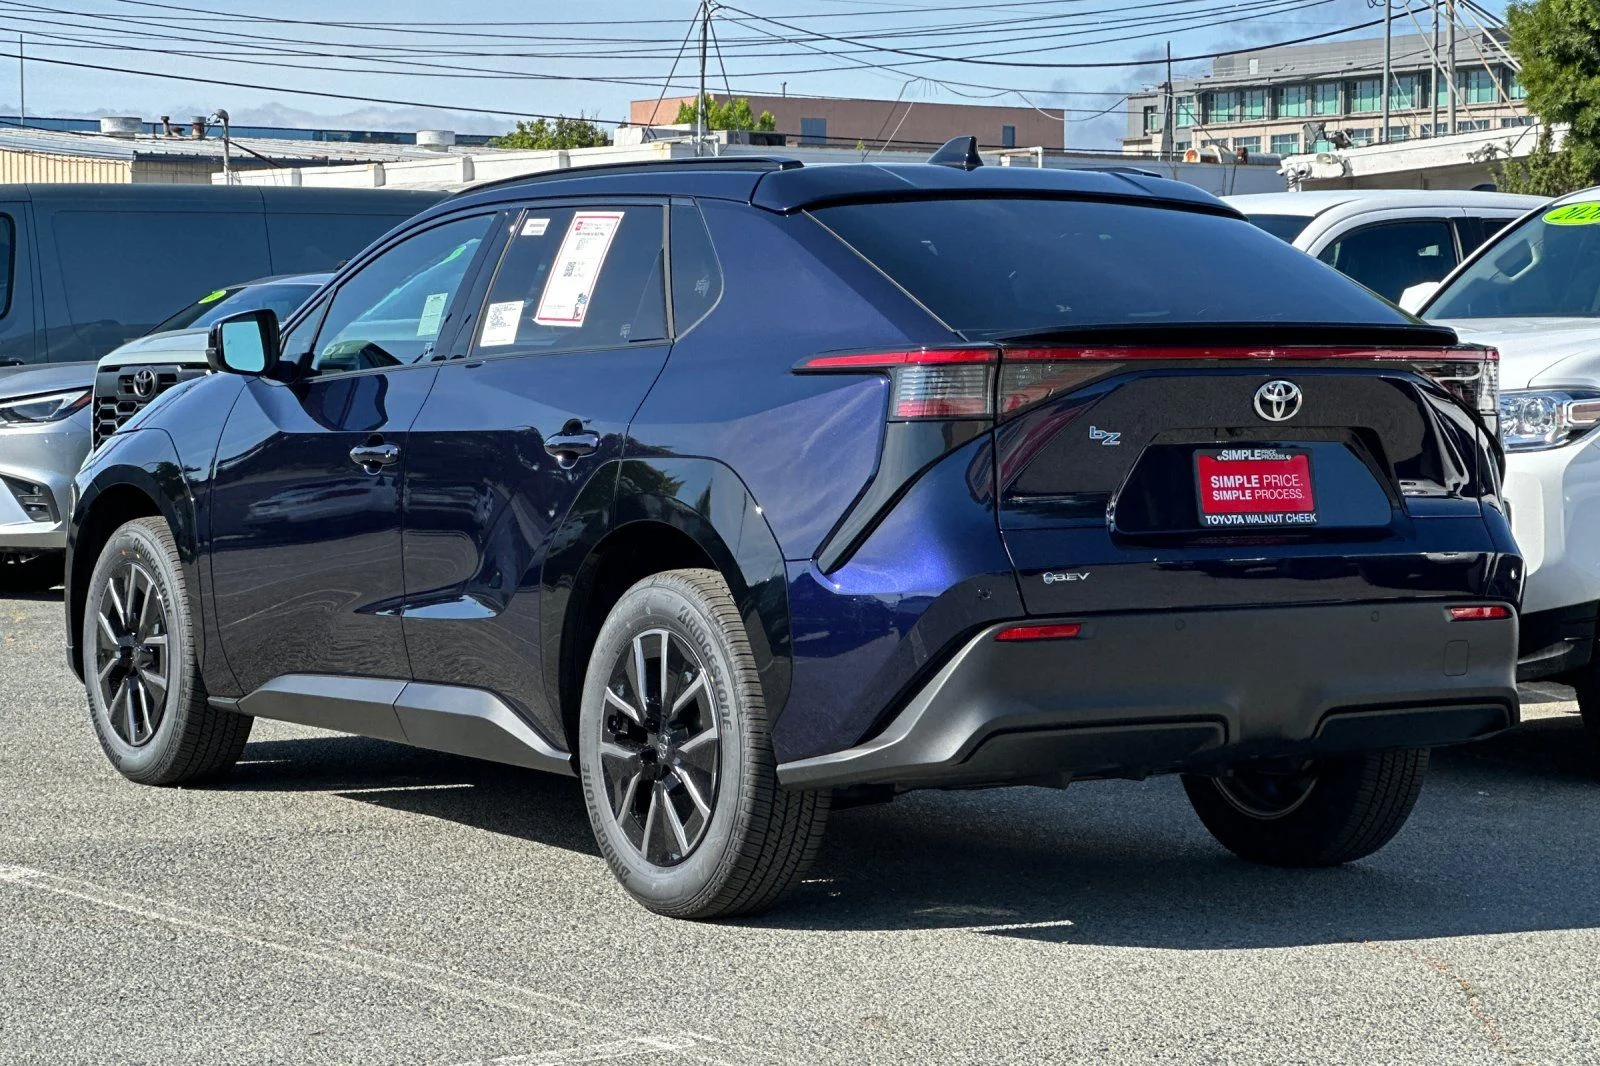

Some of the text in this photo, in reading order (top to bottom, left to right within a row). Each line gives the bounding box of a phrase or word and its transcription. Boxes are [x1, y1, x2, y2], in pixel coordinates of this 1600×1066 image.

[1221, 449, 1261, 461] SIMPLE
[1210, 474, 1304, 488] SIMPLE PRICE.
[1212, 488, 1305, 501] SIMPLE PROCESS.
[1205, 513, 1318, 525] TOYOTA WALNUT CHEEK
[132, 537, 173, 617] BRIDGESTONE
[677, 605, 733, 731] BRIDGESTONE
[581, 762, 632, 884] BRIDGESTONE
